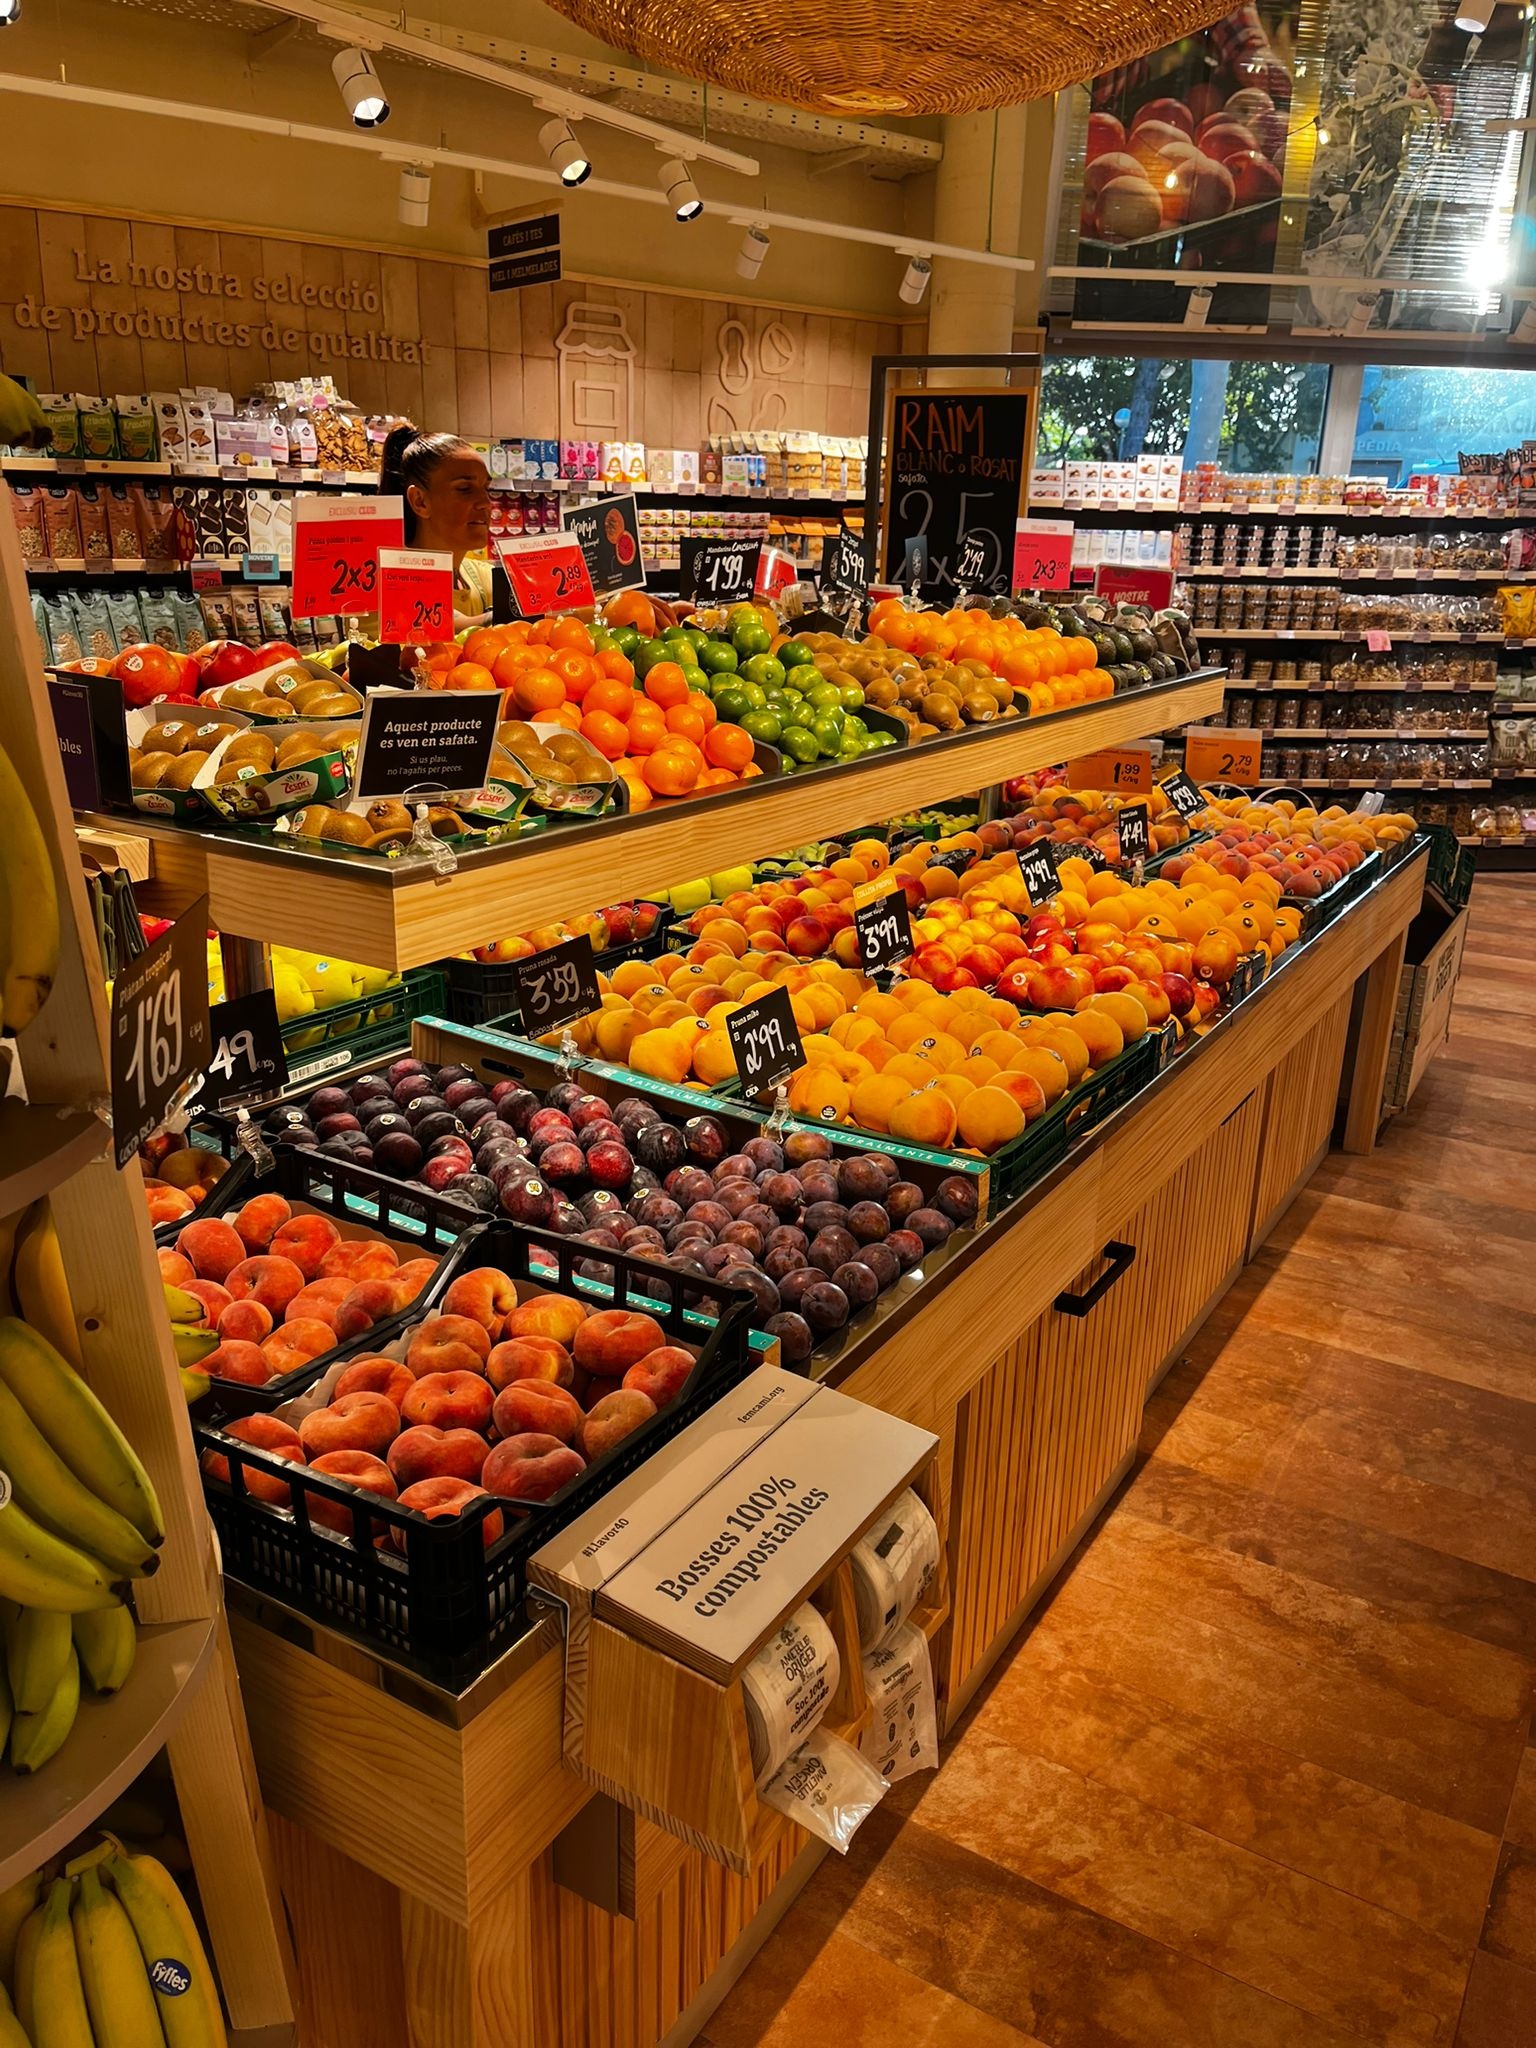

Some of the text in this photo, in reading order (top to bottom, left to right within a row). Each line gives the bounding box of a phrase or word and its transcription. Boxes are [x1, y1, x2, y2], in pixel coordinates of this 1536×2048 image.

[73, 249, 380, 313] La nostra selecció
[14, 295, 432, 365] de productes de qualitat
[901, 400, 985, 456] RAÏM
[896, 450, 954, 475] BLANC
[971, 454, 1018, 482] ROSAT
[330, 559, 377, 596] 2x3
[1113, 590, 1151, 602] NOSTRE
[380, 733, 478, 749] es ven en safata.
[384, 718, 482, 735] Aquest producte
[387, 768, 398, 776] no
[427, 765, 441, 775] per
[410, 756, 418, 765] Si
[1218, 753, 1253, 776] 2,79
[281, 778, 311, 795] Zespri
[476, 790, 506, 804] Zespri
[569, 792, 595, 803] Zespri
[1121, 820, 1144, 848] 4'49
[864, 915, 899, 959] 3'99
[518, 965, 538, 976] Pruna
[526, 962, 581, 1016] 3'59
[730, 1016, 747, 1029] Pruna
[744, 1017, 785, 1075] 2'99
[626, 1076, 726, 1110] NATURALMENTE
[818, 1129, 936, 1161] NATURALMENTE
[737, 1385, 787, 1425] femcami.org
[582, 1517, 630, 1559] #Llavor40
[655, 1474, 798, 1604] Bosses 100%
[693, 1486, 831, 1619] compostables
[795, 1695, 809, 1715] Soc
[784, 1757, 821, 1795] ORIGEN
